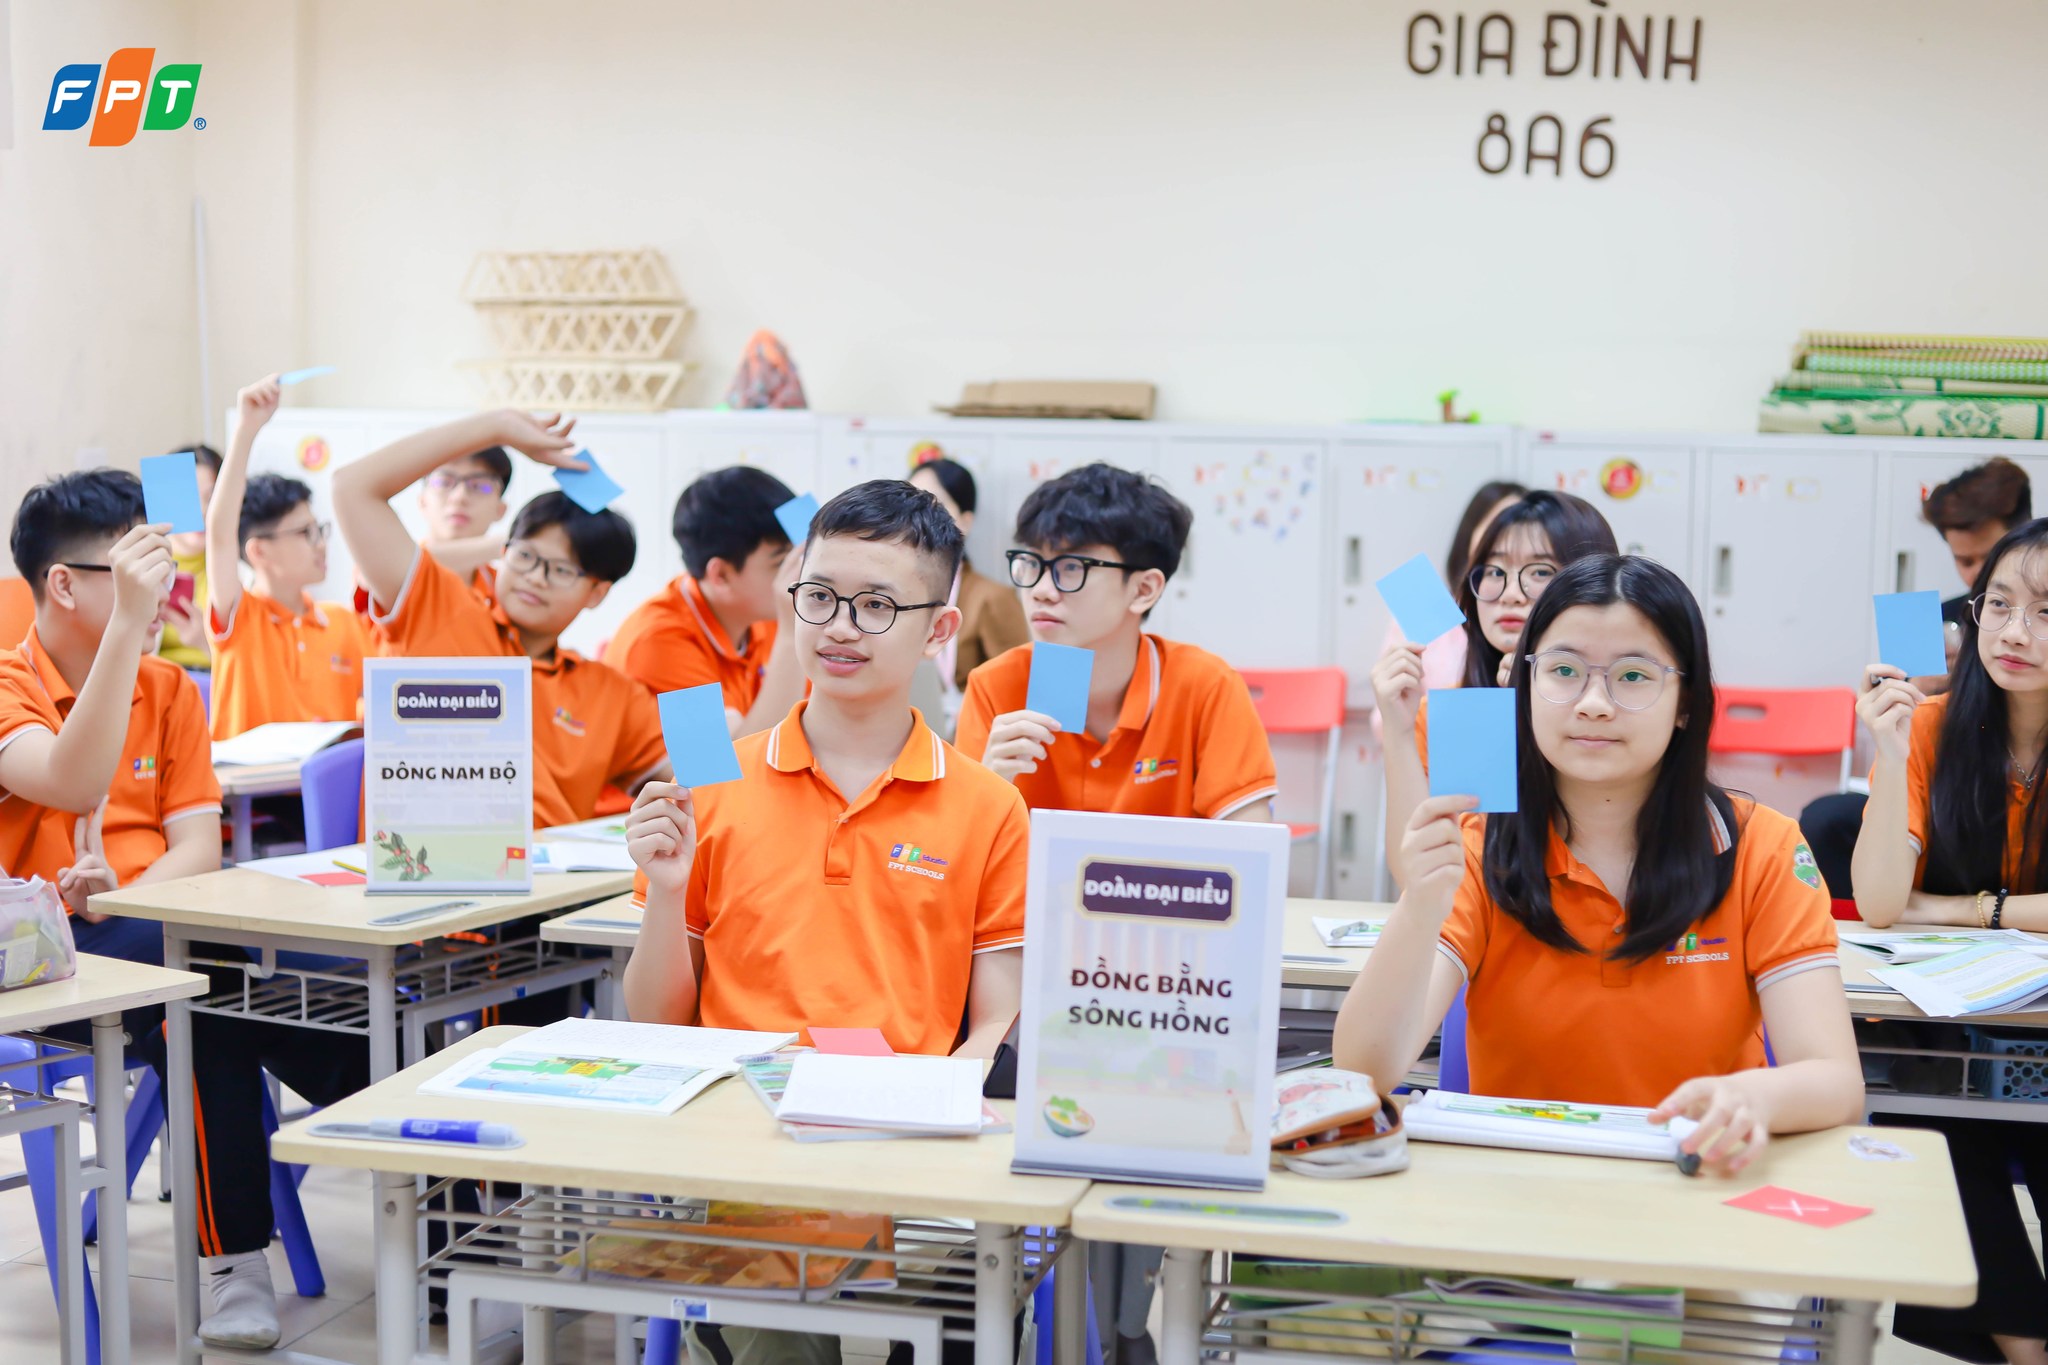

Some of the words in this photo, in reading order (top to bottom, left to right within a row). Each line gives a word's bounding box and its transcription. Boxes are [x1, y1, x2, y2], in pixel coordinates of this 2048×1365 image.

[1406, 13, 1515, 76] GIA
[1540, 0, 1705, 82] ĐÌNH
[1476, 112, 1616, 179] 8A6
[397, 691, 439, 709] ĐOÀN
[439, 695, 465, 712] ĐẠI
[465, 688, 499, 709] BIỂU
[381, 760, 437, 780] ĐÔNG
[441, 766, 485, 780] NAM
[489, 760, 517, 785] BỘ
[888, 861, 905, 871] FPT
[1084, 874, 1142, 899] ĐOÀN
[1143, 883, 1180, 907] ĐẠI
[1181, 876, 1230, 906] BIỂU
[1071, 955, 1149, 993] ĐỒNG
[1157, 961, 1232, 998] BẰNG
[1665, 955, 1684, 965] FPT
[1068, 997, 1142, 1029] SÔNG
[1150, 998, 1230, 1036] HỒNG
